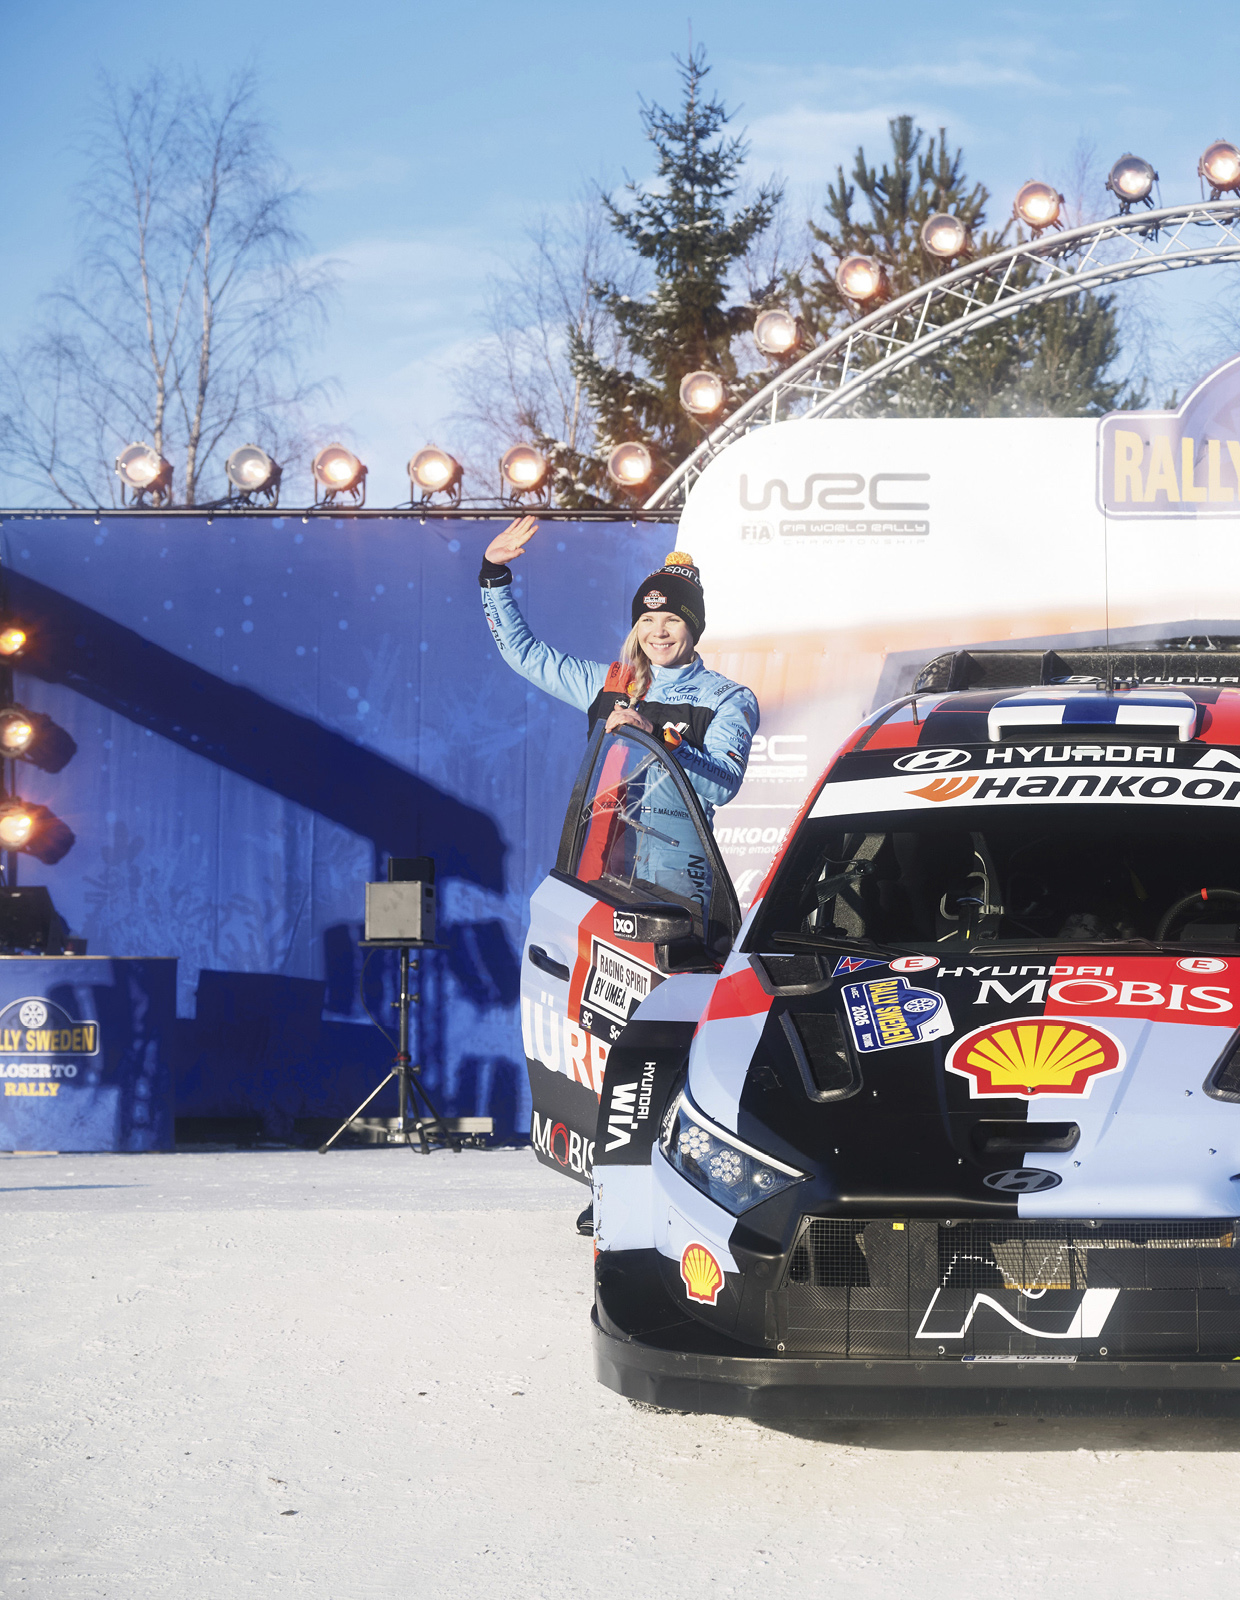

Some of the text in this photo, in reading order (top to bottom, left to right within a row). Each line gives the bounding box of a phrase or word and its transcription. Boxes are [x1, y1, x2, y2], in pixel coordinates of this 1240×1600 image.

[739, 472, 931, 511] WRC
[783, 523, 927, 533] FIA WORLD RALLY
[485, 590, 503, 627] HYUNDAI
[665, 694, 701, 703] HYUNDAI
[985, 745, 1176, 765] HYUNDAI
[692, 754, 735, 785] HYUNDAI
[600, 954, 648, 996] RACING SPIRIT
[904, 958, 924, 969] E
[936, 964, 1115, 979] HYUNDAI
[1191, 958, 1212, 970] E
[593, 976, 627, 1010] BY UMEÅ.
[972, 978, 1234, 1014] MOBIS
[582, 1010, 593, 1026] SC
[851, 1004, 871, 1027] 2026
[868, 980, 916, 1045] RALLY SWEDEN
[25, 1026, 95, 1052] SWEDEN
[52, 1063, 78, 1078] TO
[4, 1082, 61, 1097] RALLY
[636, 1061, 657, 1120] HYUNDAI
